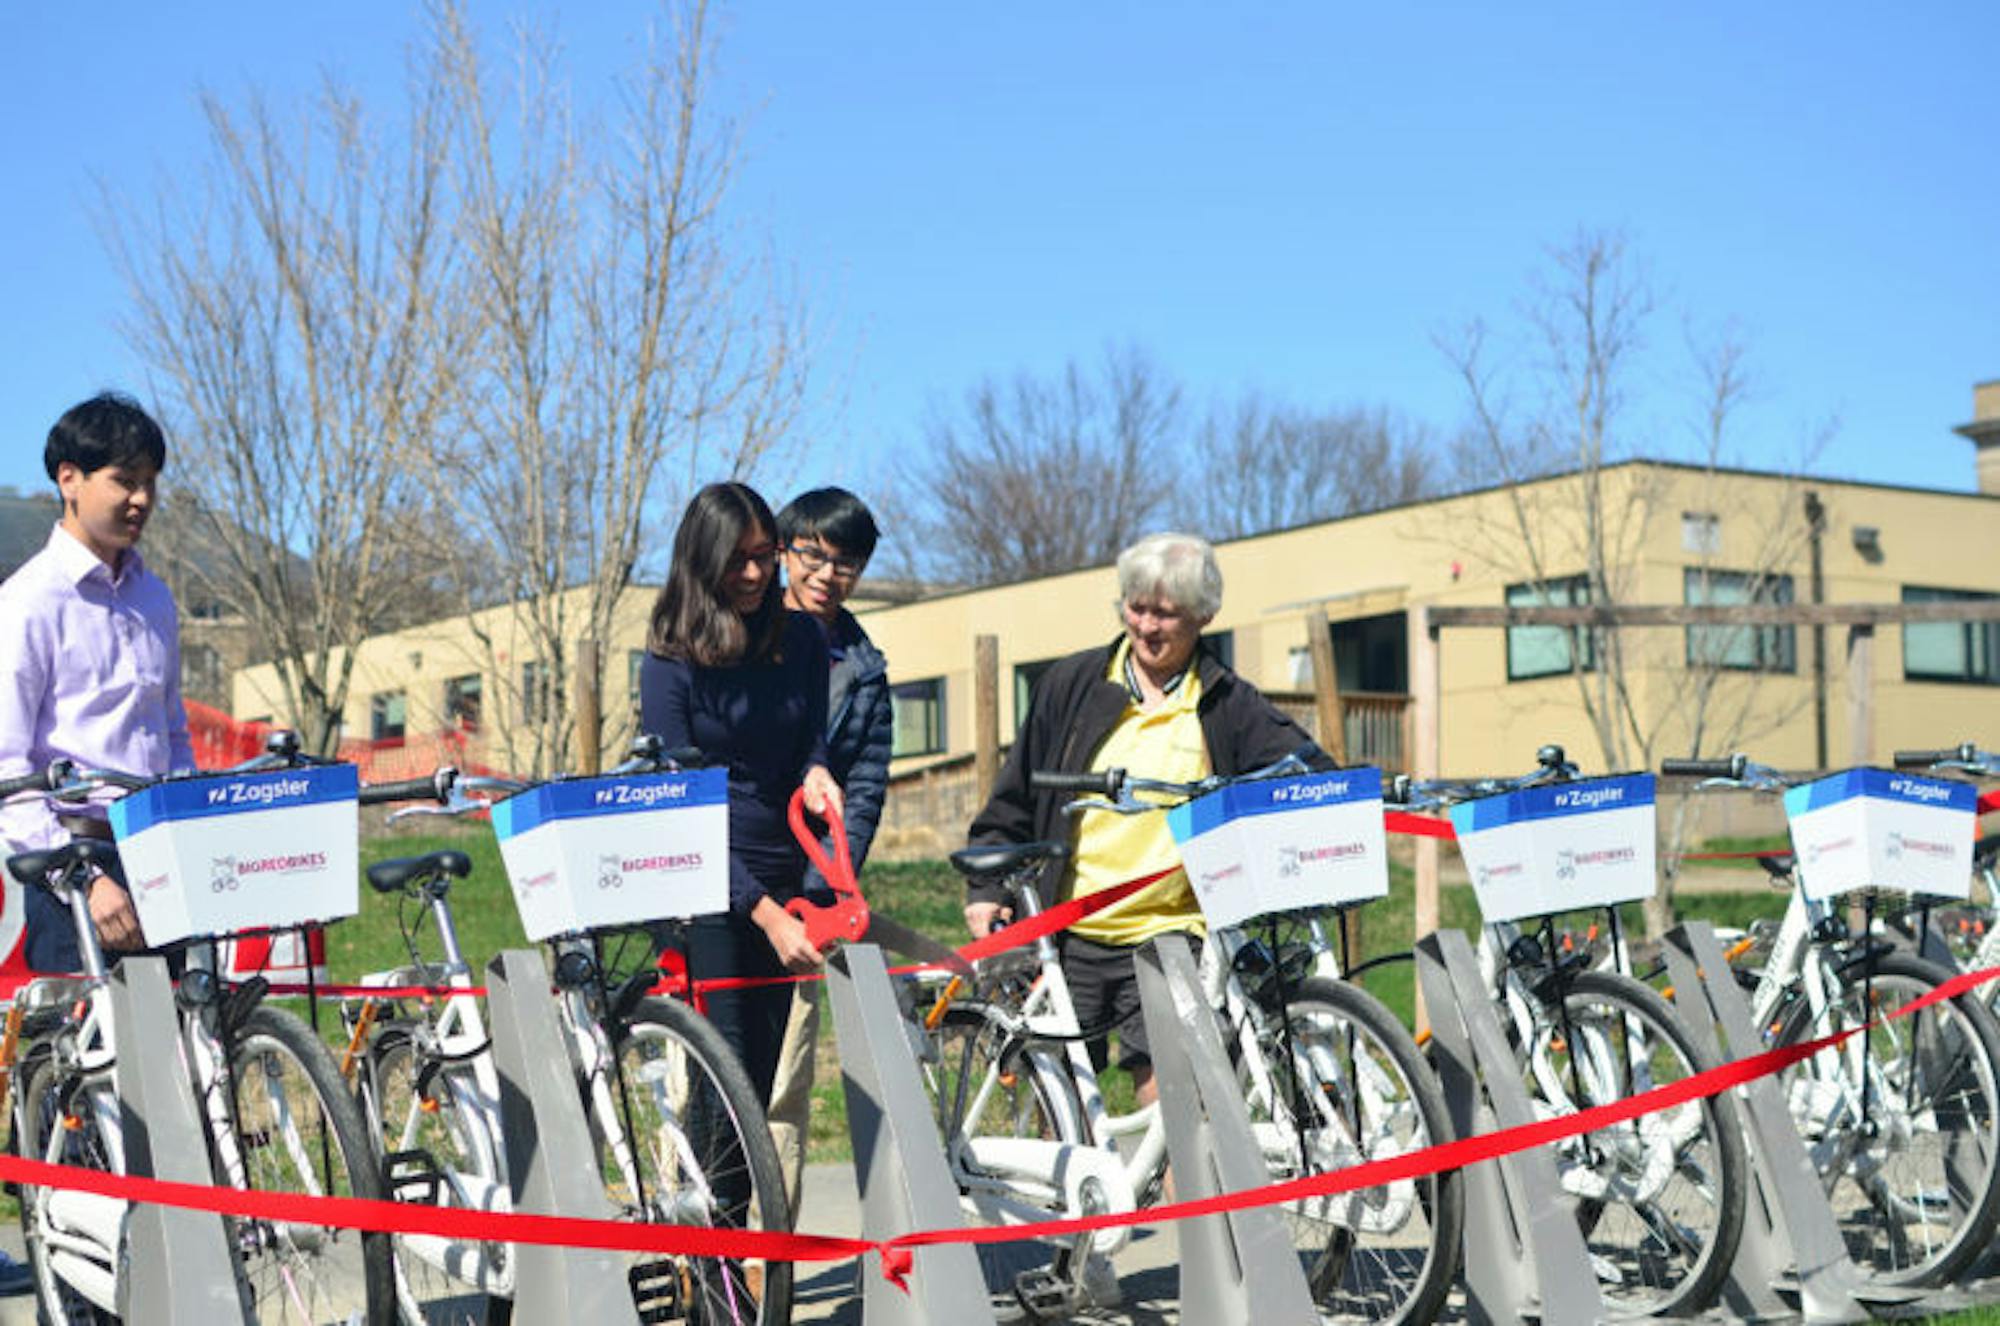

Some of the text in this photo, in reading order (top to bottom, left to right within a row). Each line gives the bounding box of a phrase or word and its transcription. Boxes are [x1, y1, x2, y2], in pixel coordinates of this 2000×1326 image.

[229, 779, 310, 803] Zagster
[614, 782, 687, 805] Zagster
[1289, 780, 1349, 801] Zagster
[1569, 786, 1623, 808] Zagster
[237, 851, 326, 875] BIGREDBIKES
